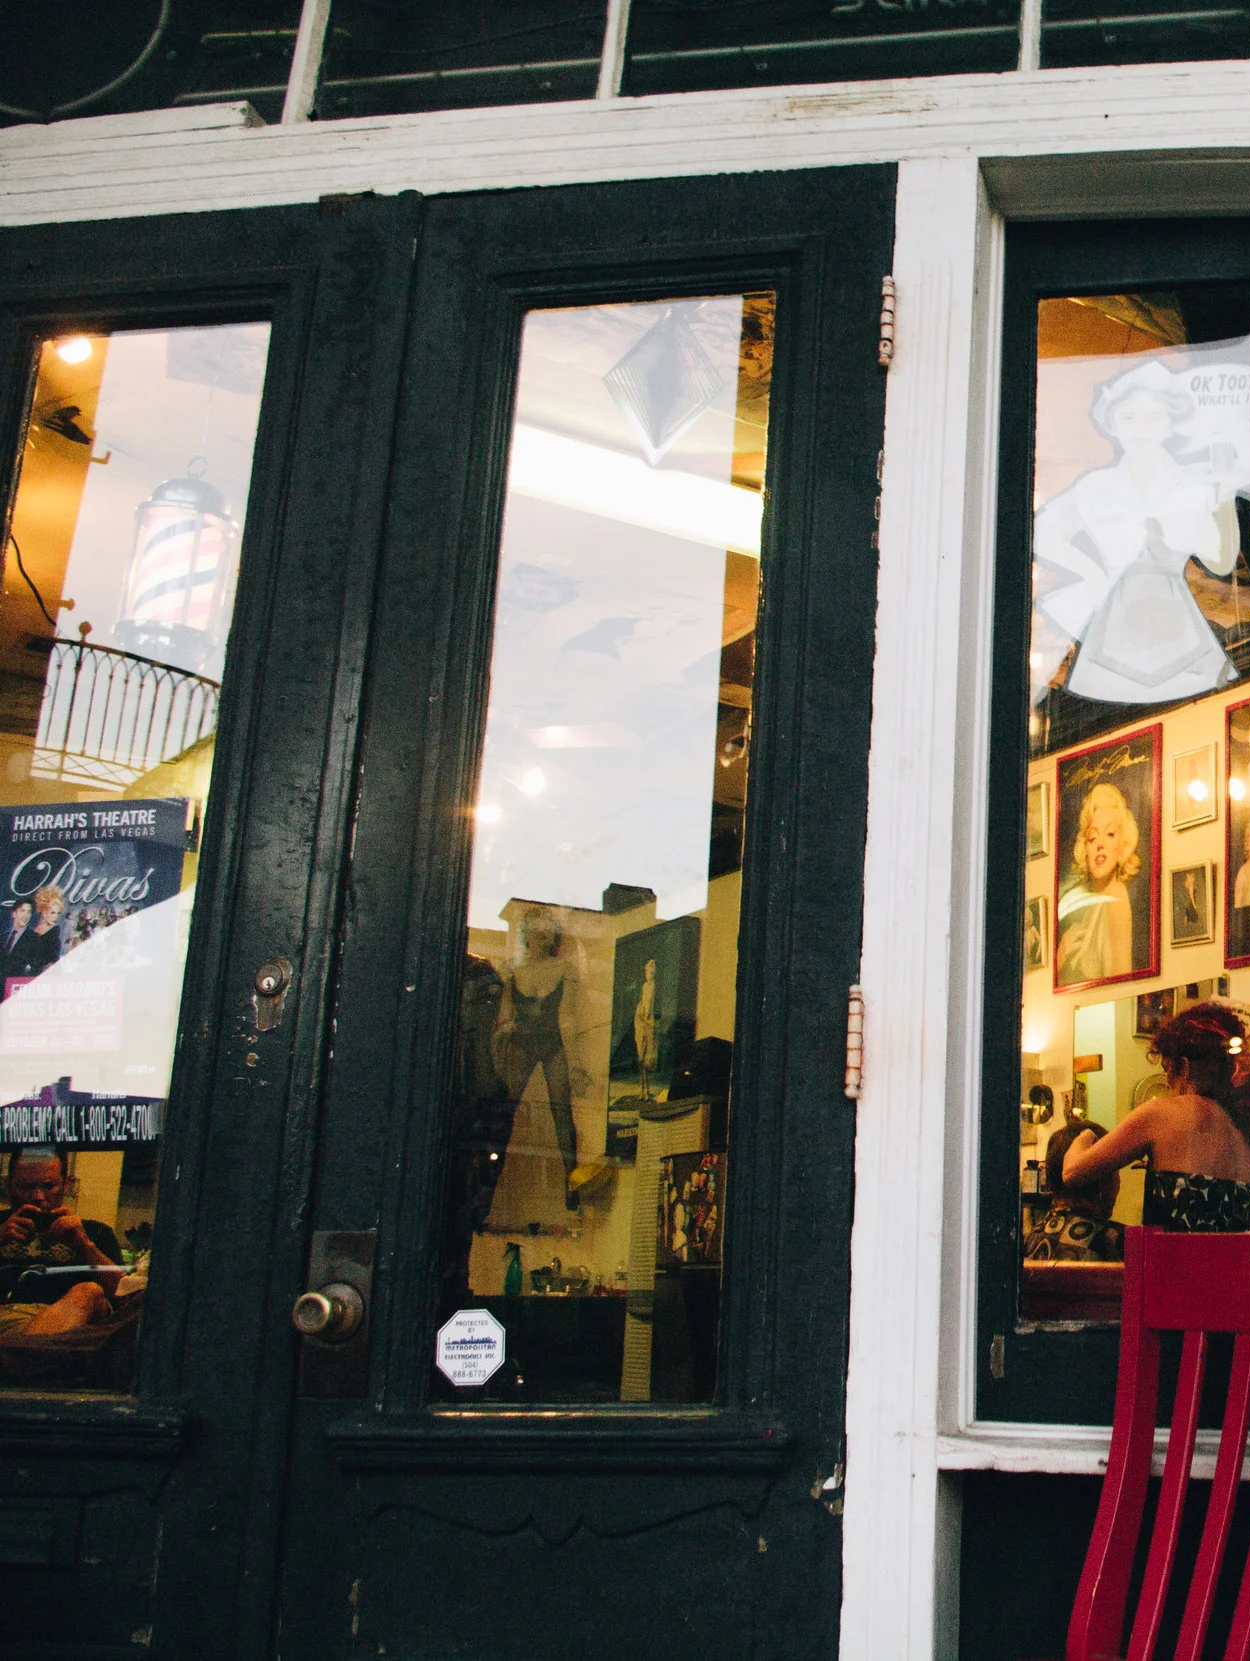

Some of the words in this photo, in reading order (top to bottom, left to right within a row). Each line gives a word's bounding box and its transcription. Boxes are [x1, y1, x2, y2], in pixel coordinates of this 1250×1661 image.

[1190, 375, 1213, 392] OK
[14, 811, 88, 831] HARRAH'S
[92, 808, 157, 828] THEATRE
[12, 832, 52, 842] DIRECT
[58, 830, 88, 840] FROM
[94, 828, 115, 838] LAS
[120, 826, 156, 838] VEGAS
[11, 847, 155, 904] Divas
[4, 1105, 53, 1142] PROBLEM?
[54, 1105, 79, 1142] CALL
